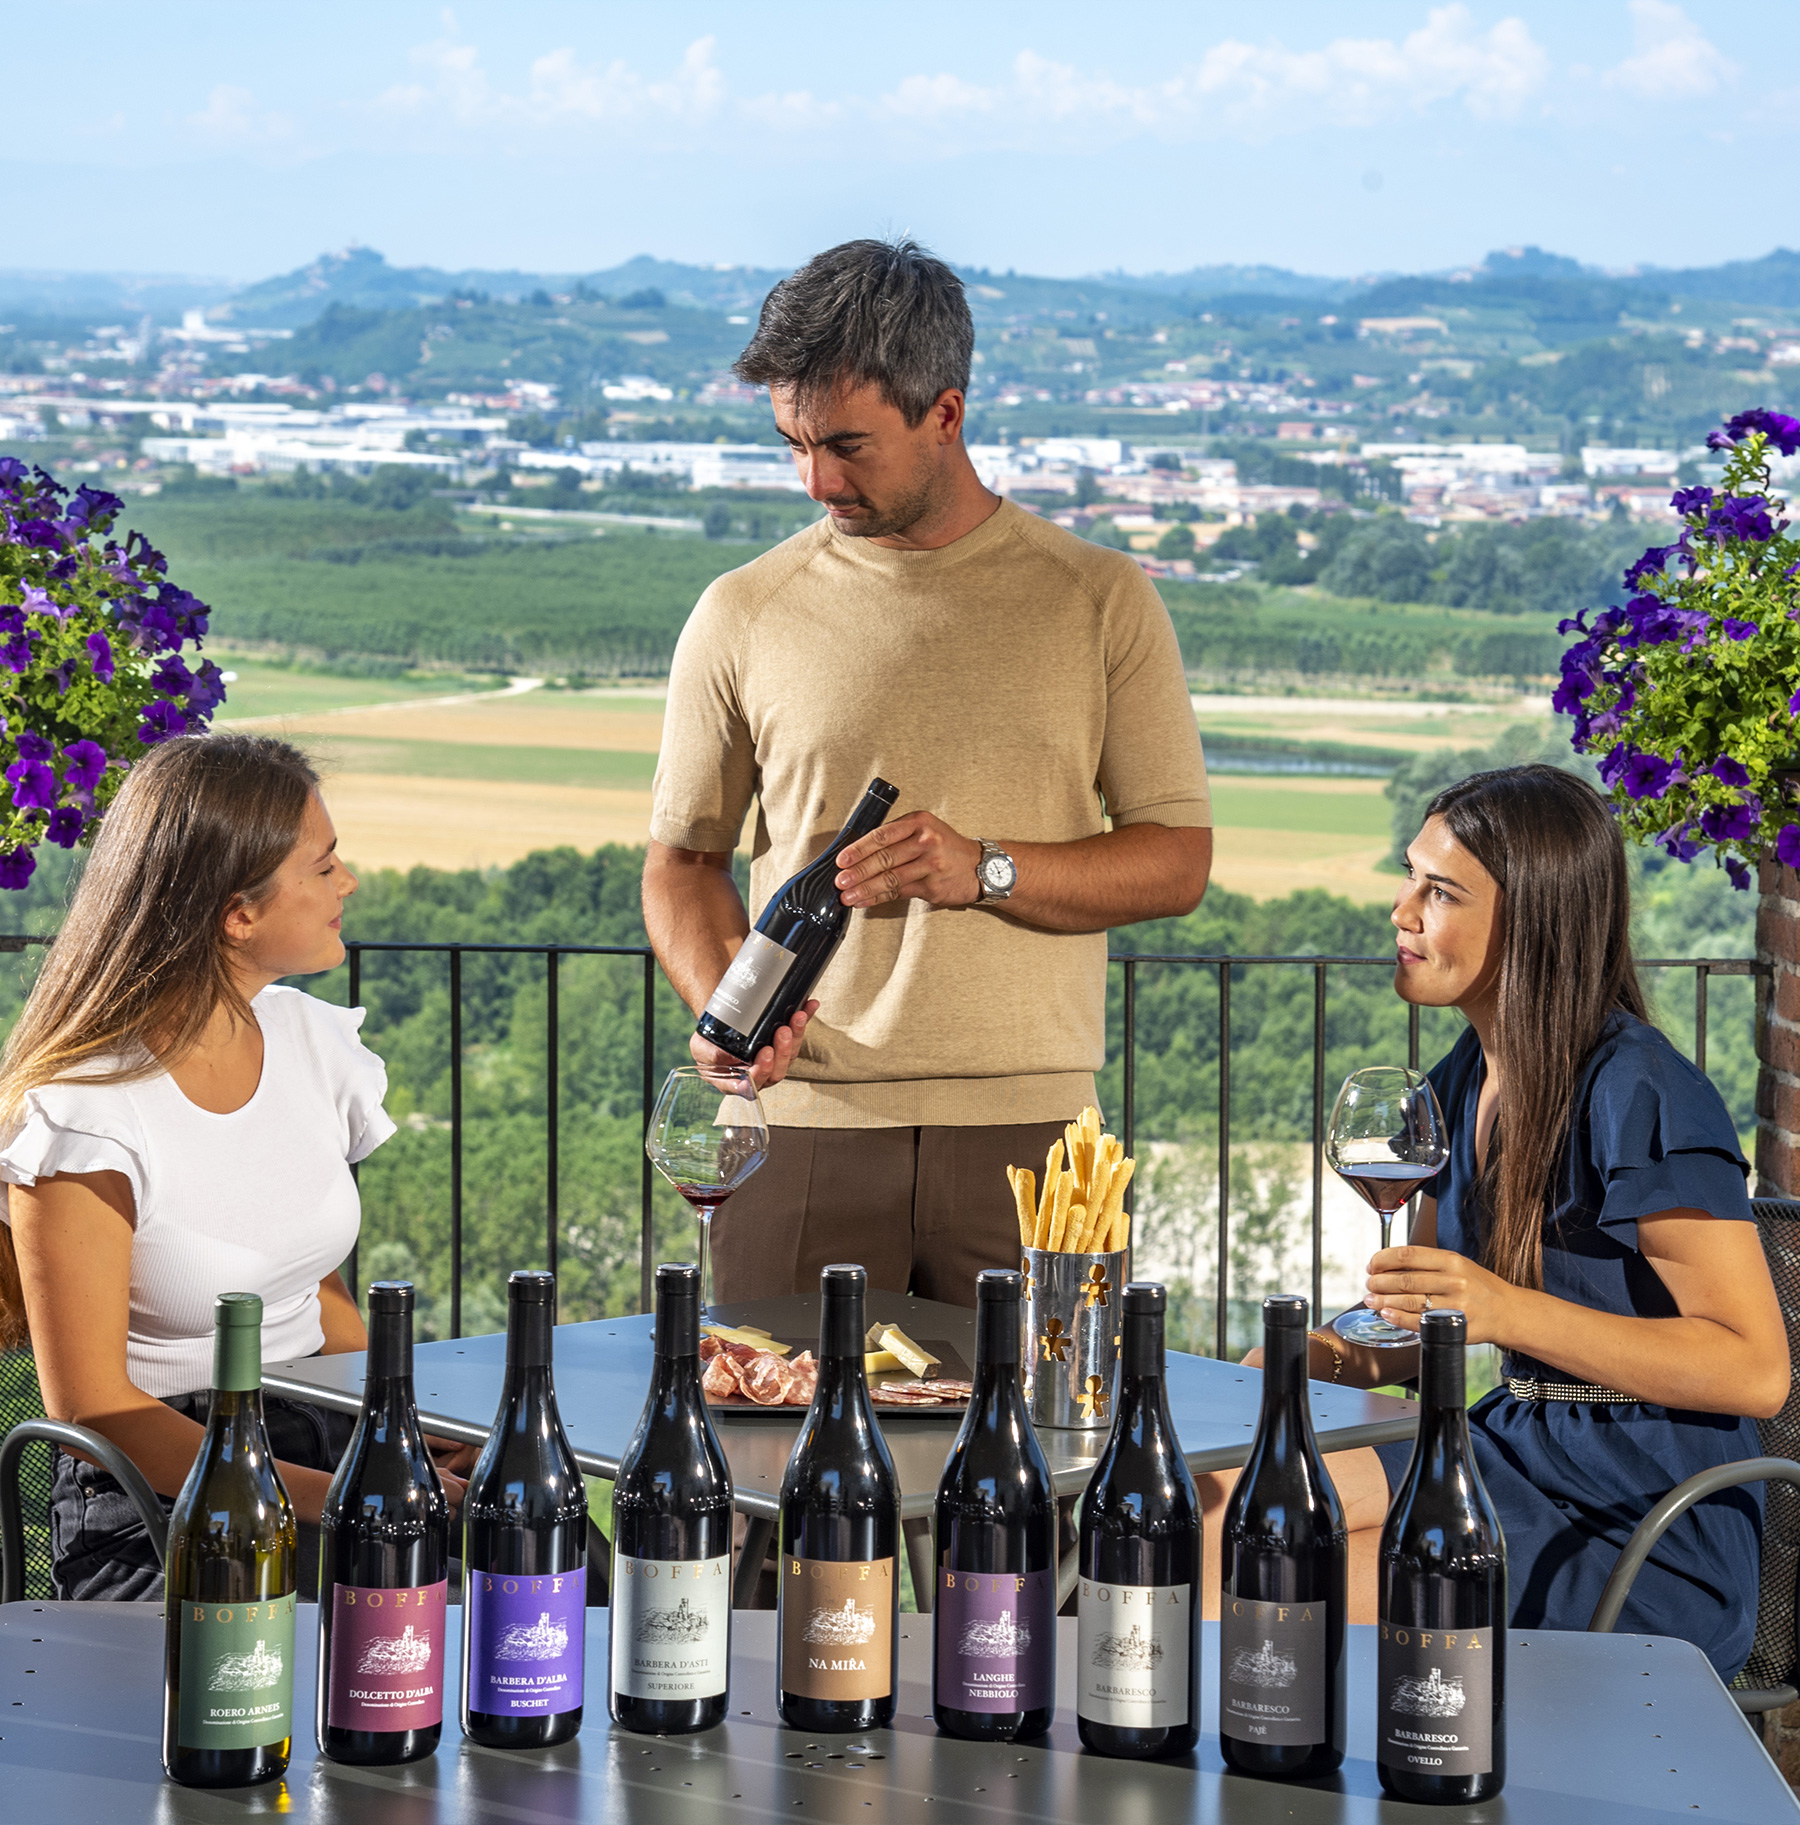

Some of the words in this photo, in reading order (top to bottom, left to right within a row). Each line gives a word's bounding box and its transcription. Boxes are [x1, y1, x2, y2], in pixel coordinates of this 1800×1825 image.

[625, 1560, 722, 1579] BOFFA
[792, 1561, 888, 1581] BOFFA
[482, 1576, 579, 1594] BOFFA
[344, 1587, 442, 1608] BOFFA
[1083, 1583, 1180, 1606] BOFFA
[193, 1600, 293, 1623] BOFFA
[1224, 1600, 1313, 1622] OFFA
[1381, 1626, 1483, 1650] BOFFA
[634, 1658, 677, 1669] BARBERA
[680, 1659, 708, 1668] D'ASTI
[808, 1657, 828, 1670] NA
[490, 1675, 535, 1686] BARBERA
[537, 1673, 568, 1685] D'ALBA
[973, 1672, 1015, 1682] LANGHE
[349, 1690, 405, 1699] DOLCETTO
[406, 1686, 434, 1698] D'ALBA
[648, 1683, 695, 1691] SUPERIORE
[968, 1688, 1019, 1698] NEBBIOLO
[1096, 1683, 1157, 1697] BARBARESCO
[210, 1708, 246, 1717] ROERO
[248, 1702, 280, 1716] ARNEIS
[511, 1699, 549, 1708] BUSCHET
[1231, 1698, 1290, 1714] BARBARESCO
[1394, 1728, 1458, 1744] BARBARESCO
[1407, 1755, 1443, 1766] OVELLO
